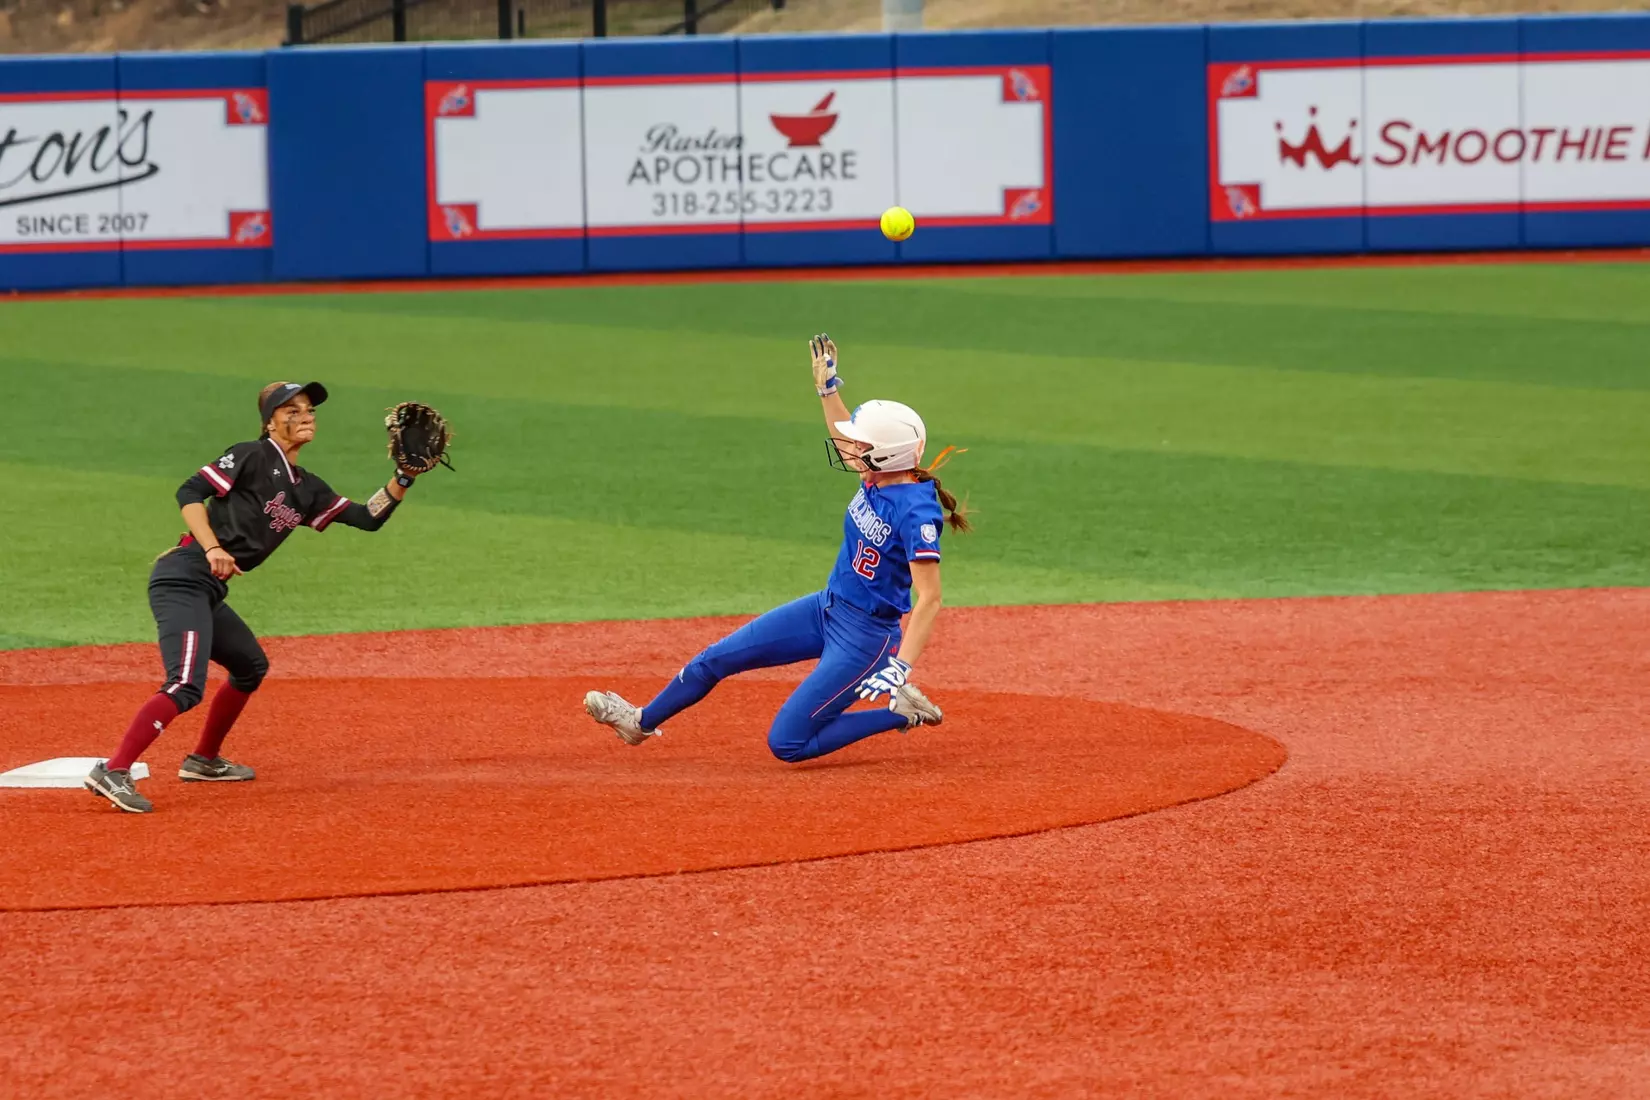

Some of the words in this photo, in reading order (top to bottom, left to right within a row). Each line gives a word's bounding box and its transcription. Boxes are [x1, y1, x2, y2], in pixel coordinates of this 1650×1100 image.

[641, 123, 744, 153] Ruston
[1374, 119, 1634, 168] SMOOTHIE
[627, 151, 858, 186] APOTHECARE
[652, 188, 833, 216] 318-255-3223
[16, 216, 89, 236] SINCE
[100, 212, 149, 233] 2007
[852, 539, 881, 580] 12
